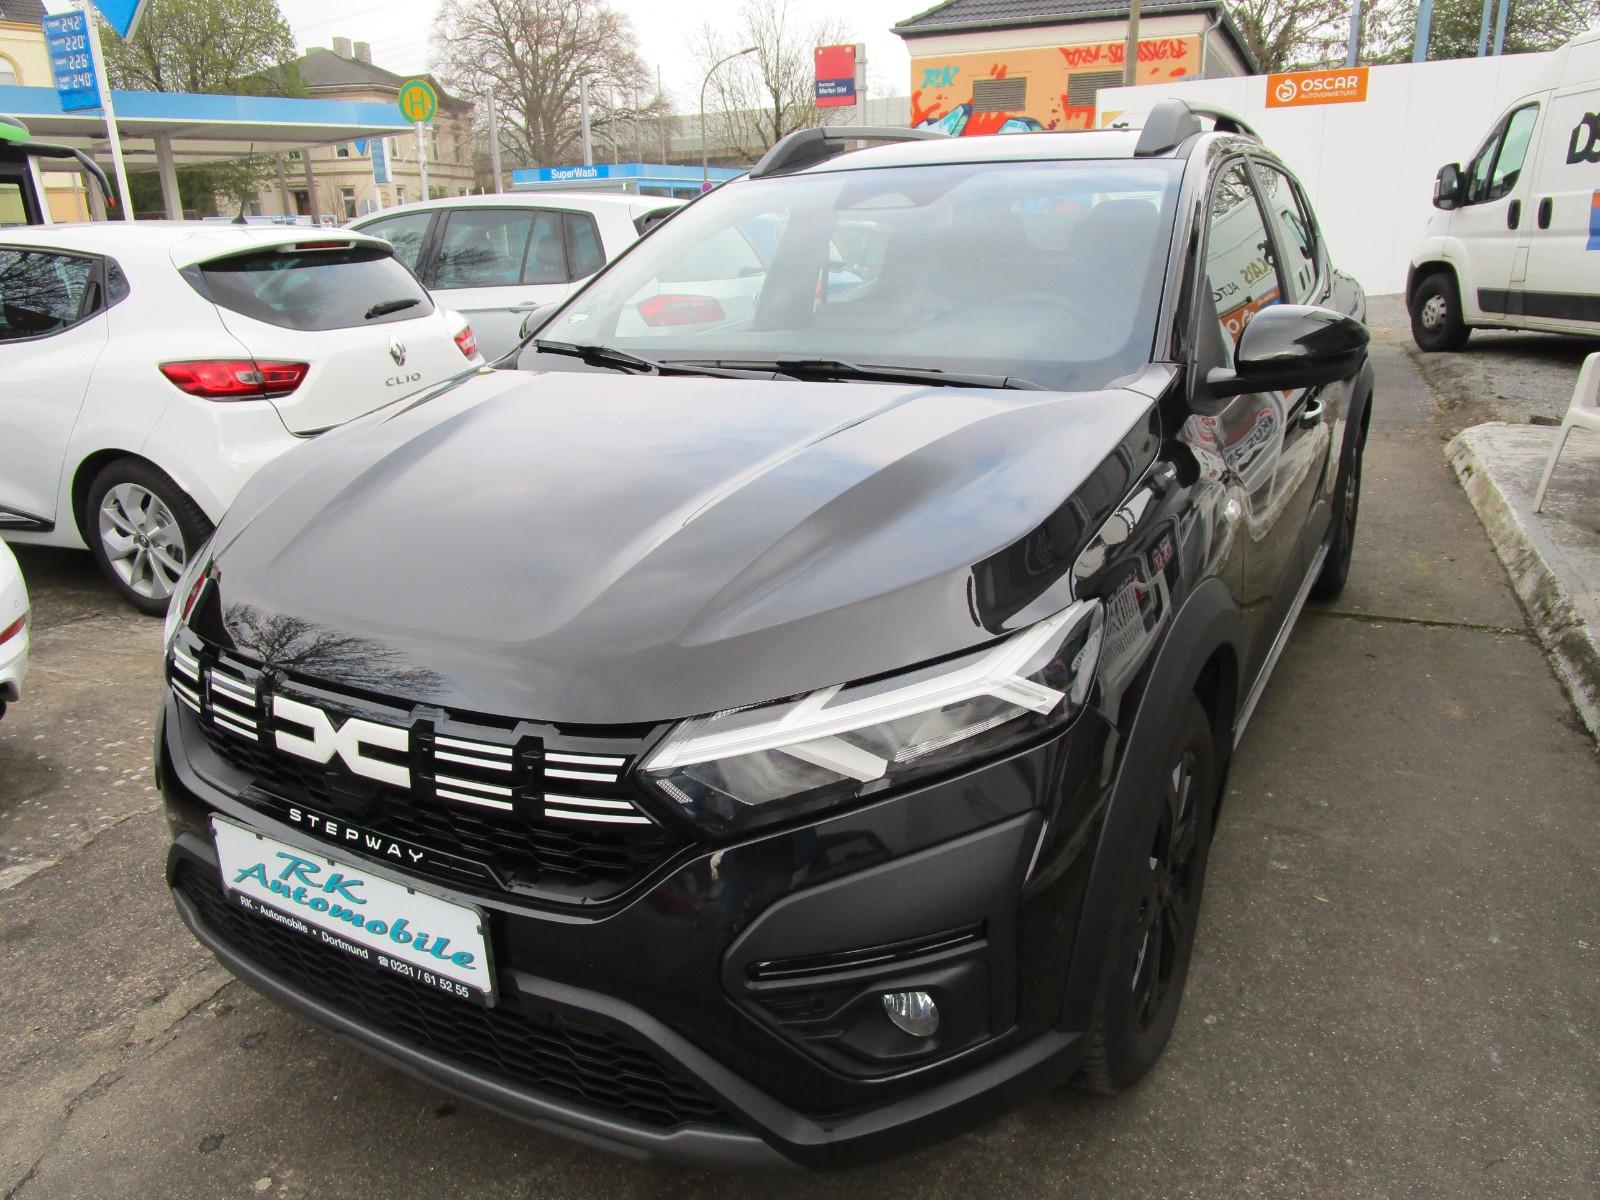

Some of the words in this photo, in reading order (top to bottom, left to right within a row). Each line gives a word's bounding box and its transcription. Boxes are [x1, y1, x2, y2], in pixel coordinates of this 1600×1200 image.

[1301, 75, 1358, 92] OSCAR
[409, 91, 426, 115] H
[551, 167, 598, 180] SuperWash
[385, 372, 422, 387] CLIO
[289, 808, 424, 863] STEPWAY
[276, 851, 367, 904] RK
[233, 863, 477, 970] Automobile
[260, 905, 308, 934] Automobile
[321, 931, 369, 959] Dortmund
[391, 959, 414, 977] 0231
[423, 973, 436, 985] 61
[440, 978, 453, 992] 52
[455, 984, 469, 998] 55
